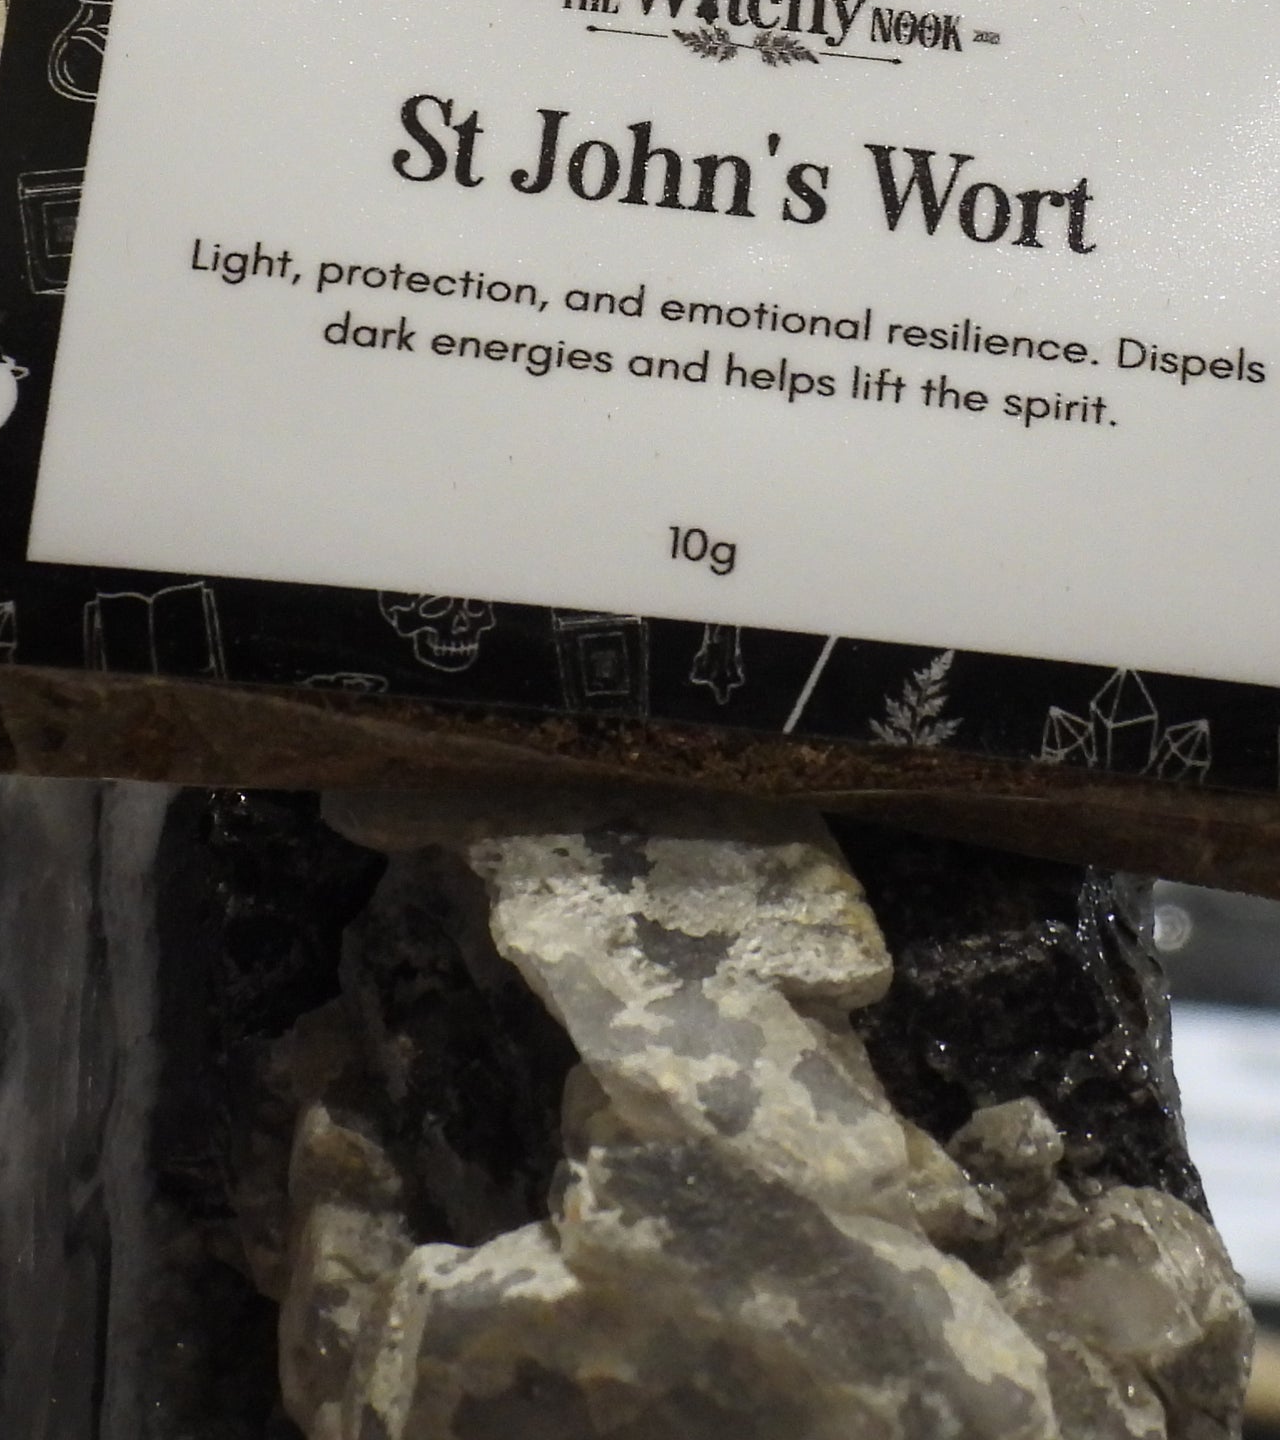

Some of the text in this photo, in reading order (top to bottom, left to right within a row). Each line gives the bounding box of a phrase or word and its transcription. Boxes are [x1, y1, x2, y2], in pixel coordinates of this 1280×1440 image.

[870, 6, 963, 53] NOOK
[391, 94, 1098, 256] St John's Wort
[192, 238, 1266, 387] Light, protection, and emotional resilience. Dispels
[323, 310, 1118, 429] dark energies and helps lift the spirit.
[669, 525, 737, 577] 10g
